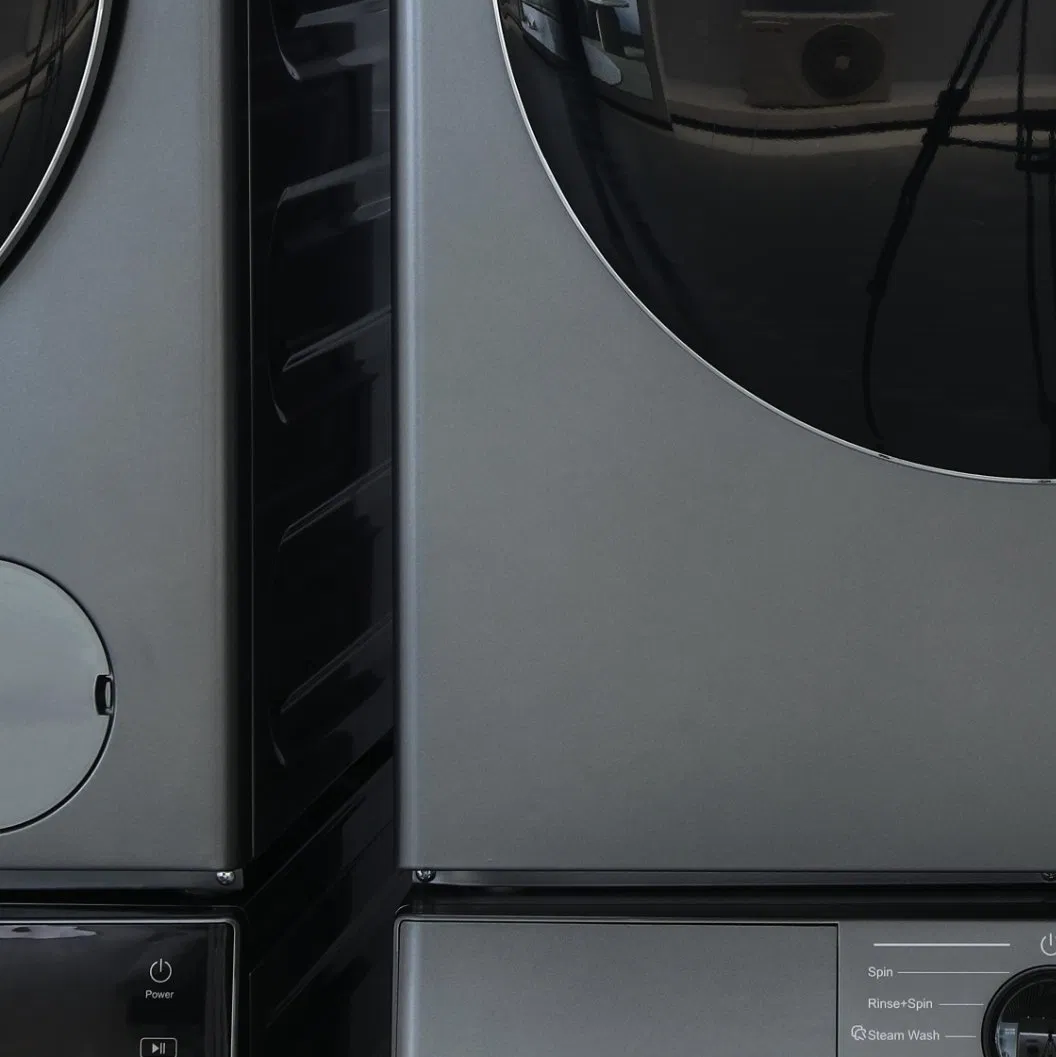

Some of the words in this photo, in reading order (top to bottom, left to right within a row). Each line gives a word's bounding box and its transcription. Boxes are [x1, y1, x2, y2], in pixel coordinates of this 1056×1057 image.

[868, 966, 893, 979] Spin
[145, 990, 174, 999] Power
[868, 998, 933, 1011] Rinse+Spin
[868, 1030, 905, 1041] Steam
[908, 1030, 940, 1041] Wash
